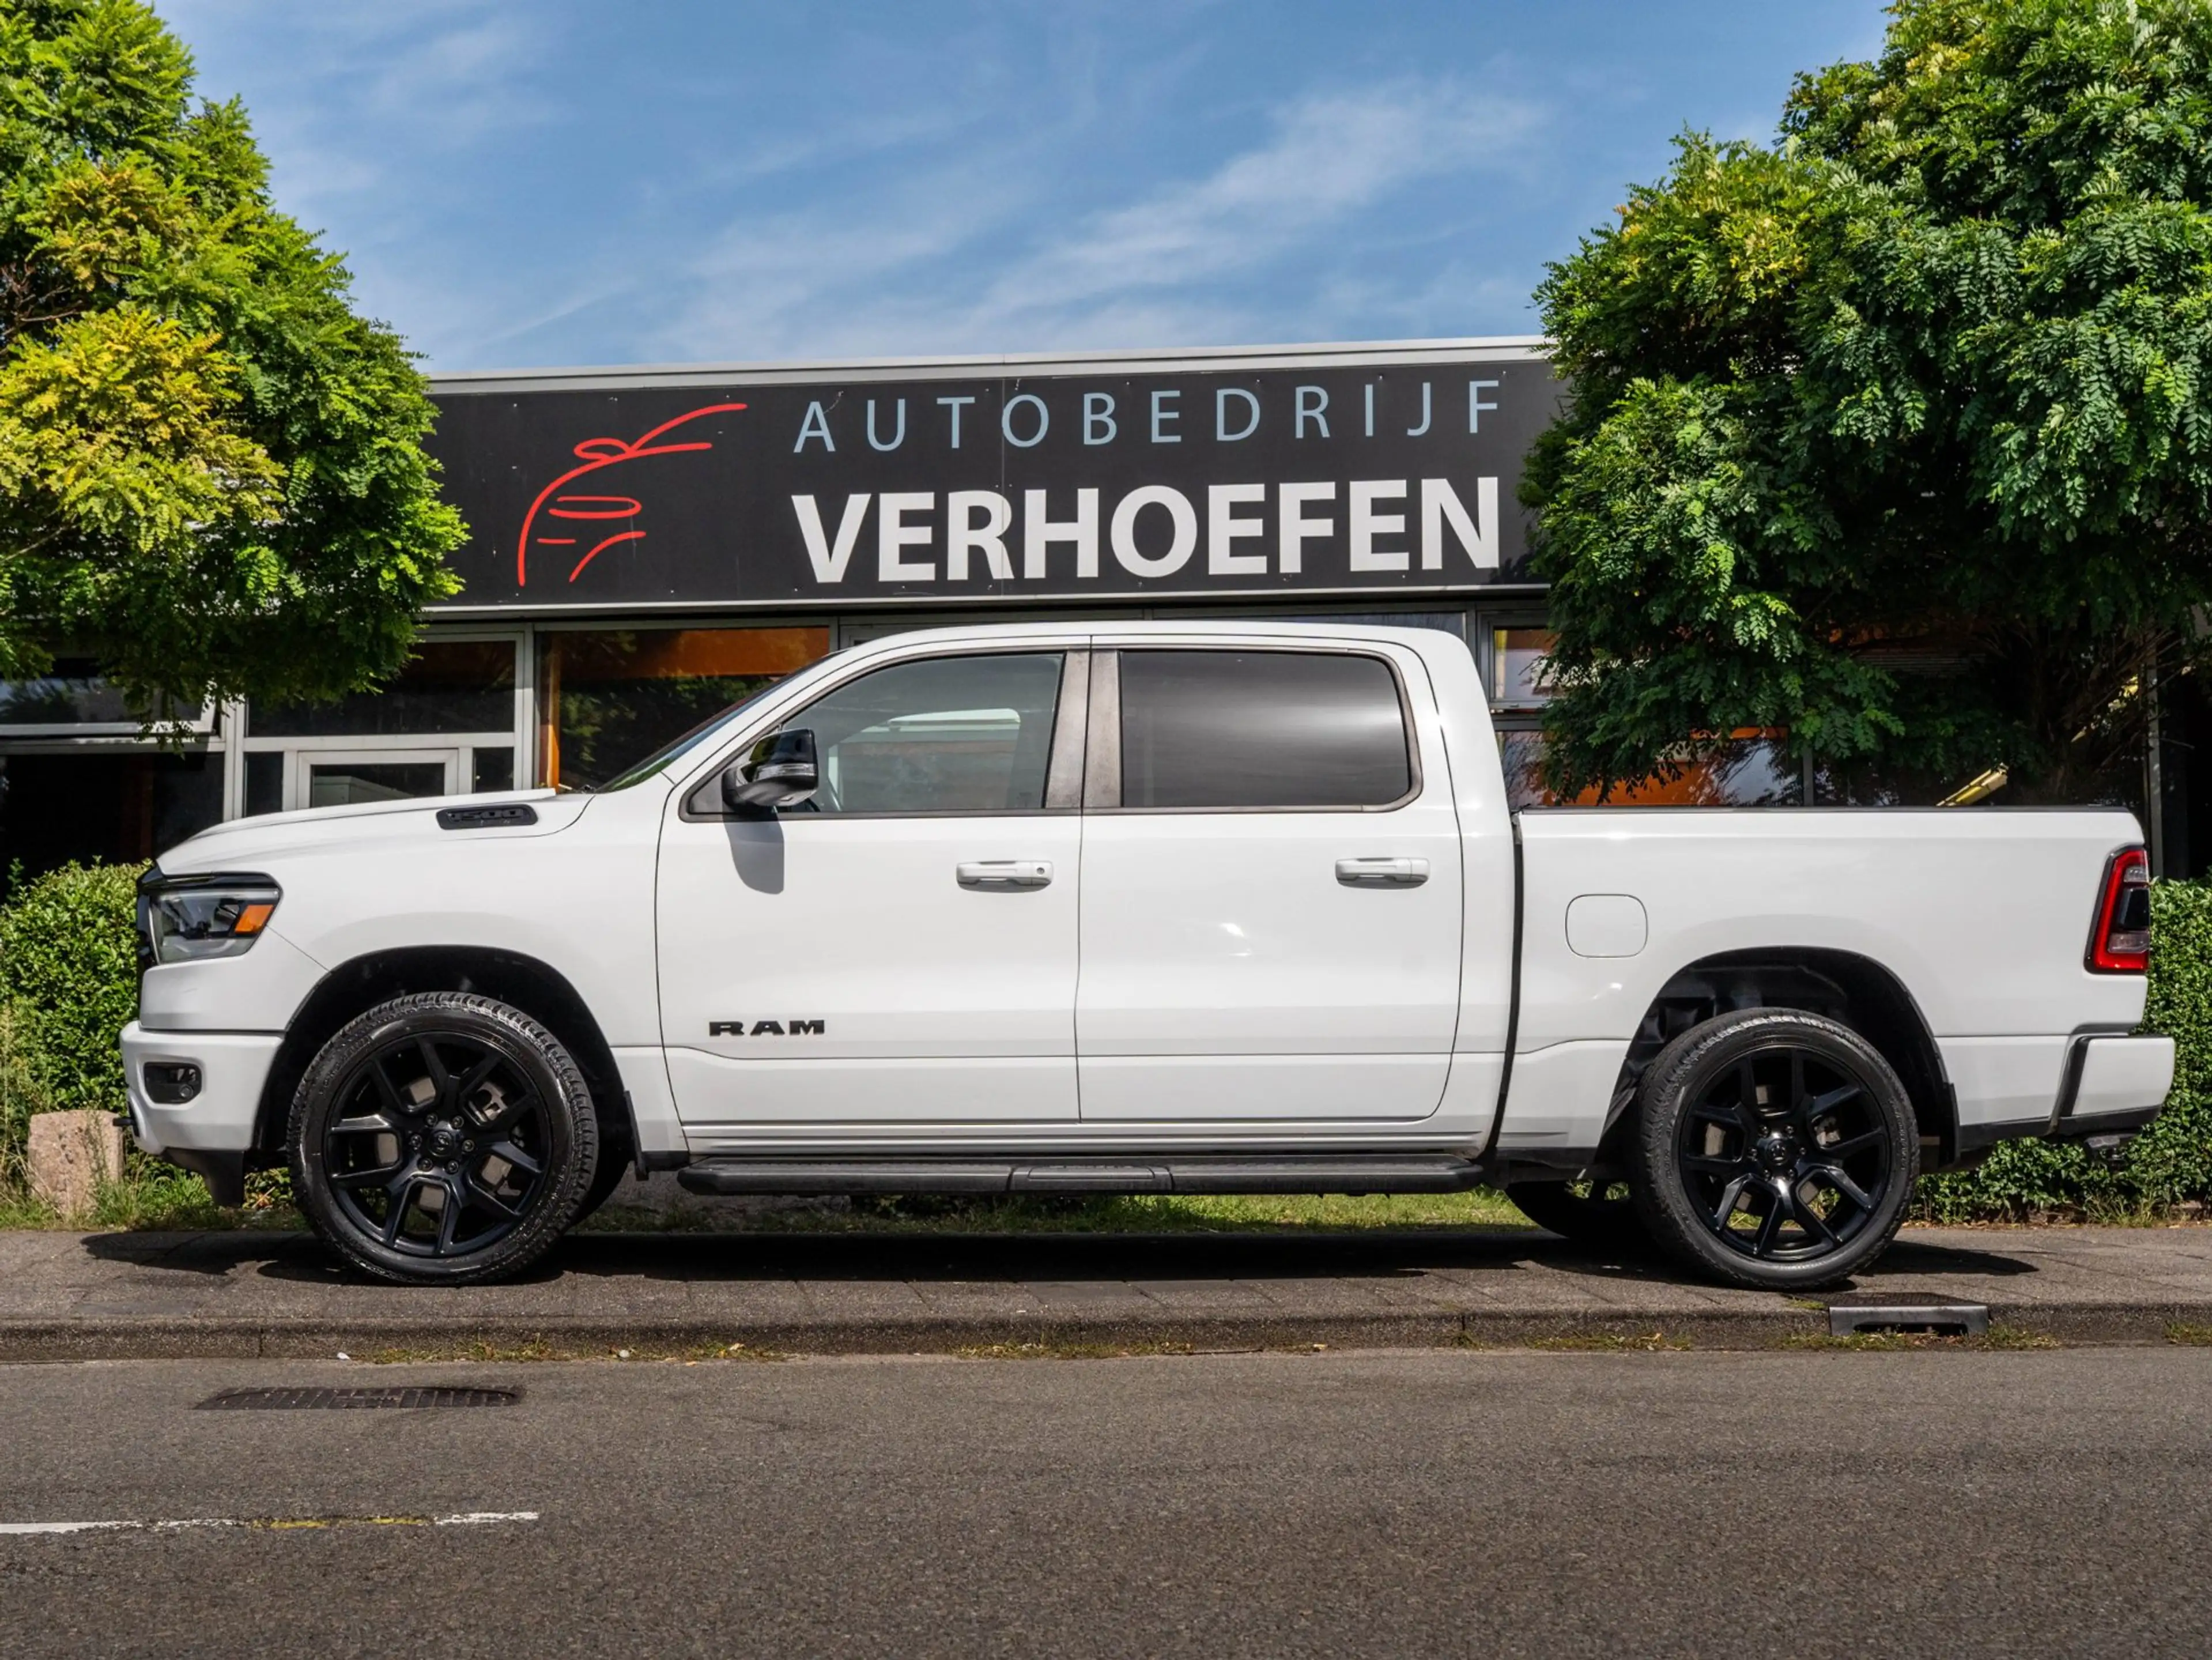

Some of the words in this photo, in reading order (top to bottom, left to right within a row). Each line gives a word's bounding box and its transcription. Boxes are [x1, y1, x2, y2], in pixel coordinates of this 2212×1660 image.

[793, 380, 1499, 453] AUTOBEDRIJF
[791, 476, 1499, 583] VERHOEFEN
[709, 1020, 825, 1036] RAM
